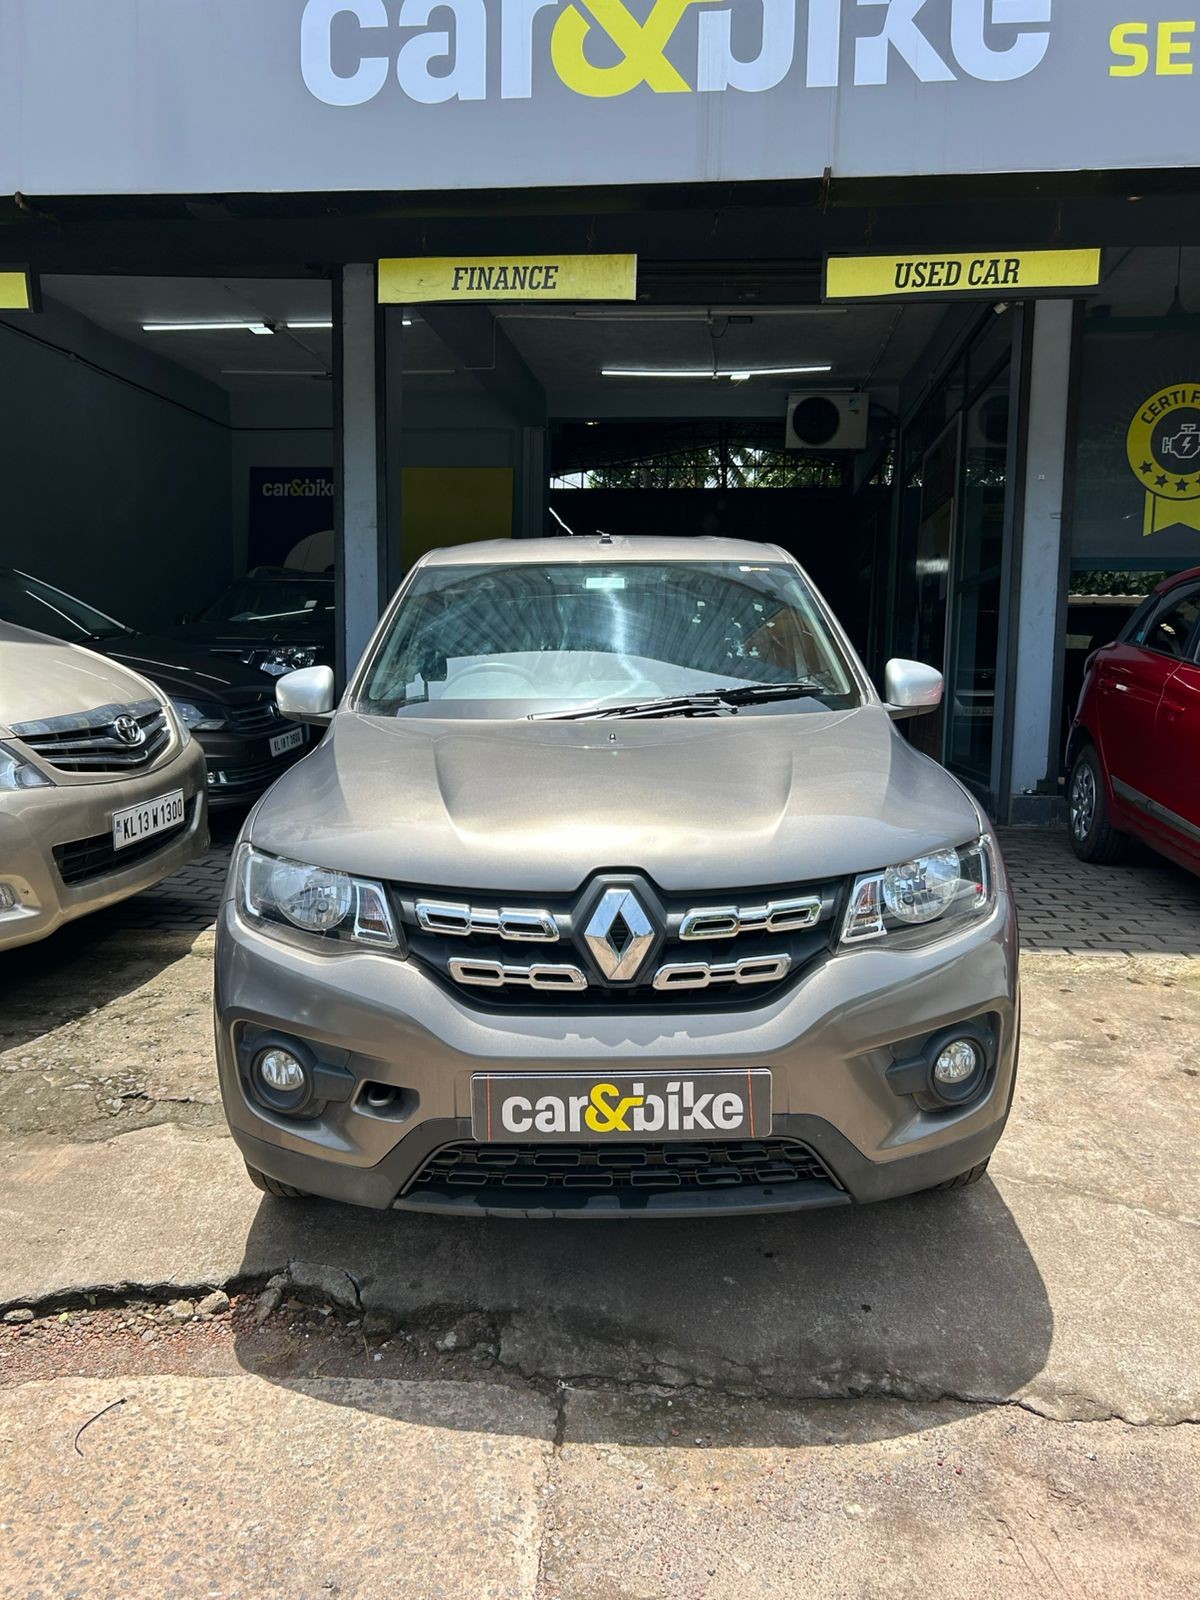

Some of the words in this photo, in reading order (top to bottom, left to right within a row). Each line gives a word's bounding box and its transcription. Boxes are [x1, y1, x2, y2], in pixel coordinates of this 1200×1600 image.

[1109, 21, 1196, 77] SE
[451, 265, 559, 291] FINANCE
[894, 261, 962, 288] USED
[967, 258, 1020, 286] CAR
[123, 816, 137, 840] KL
[138, 812, 150, 833] 13
[160, 798, 183, 825] 1300
[501, 1081, 744, 1133] car&bike
